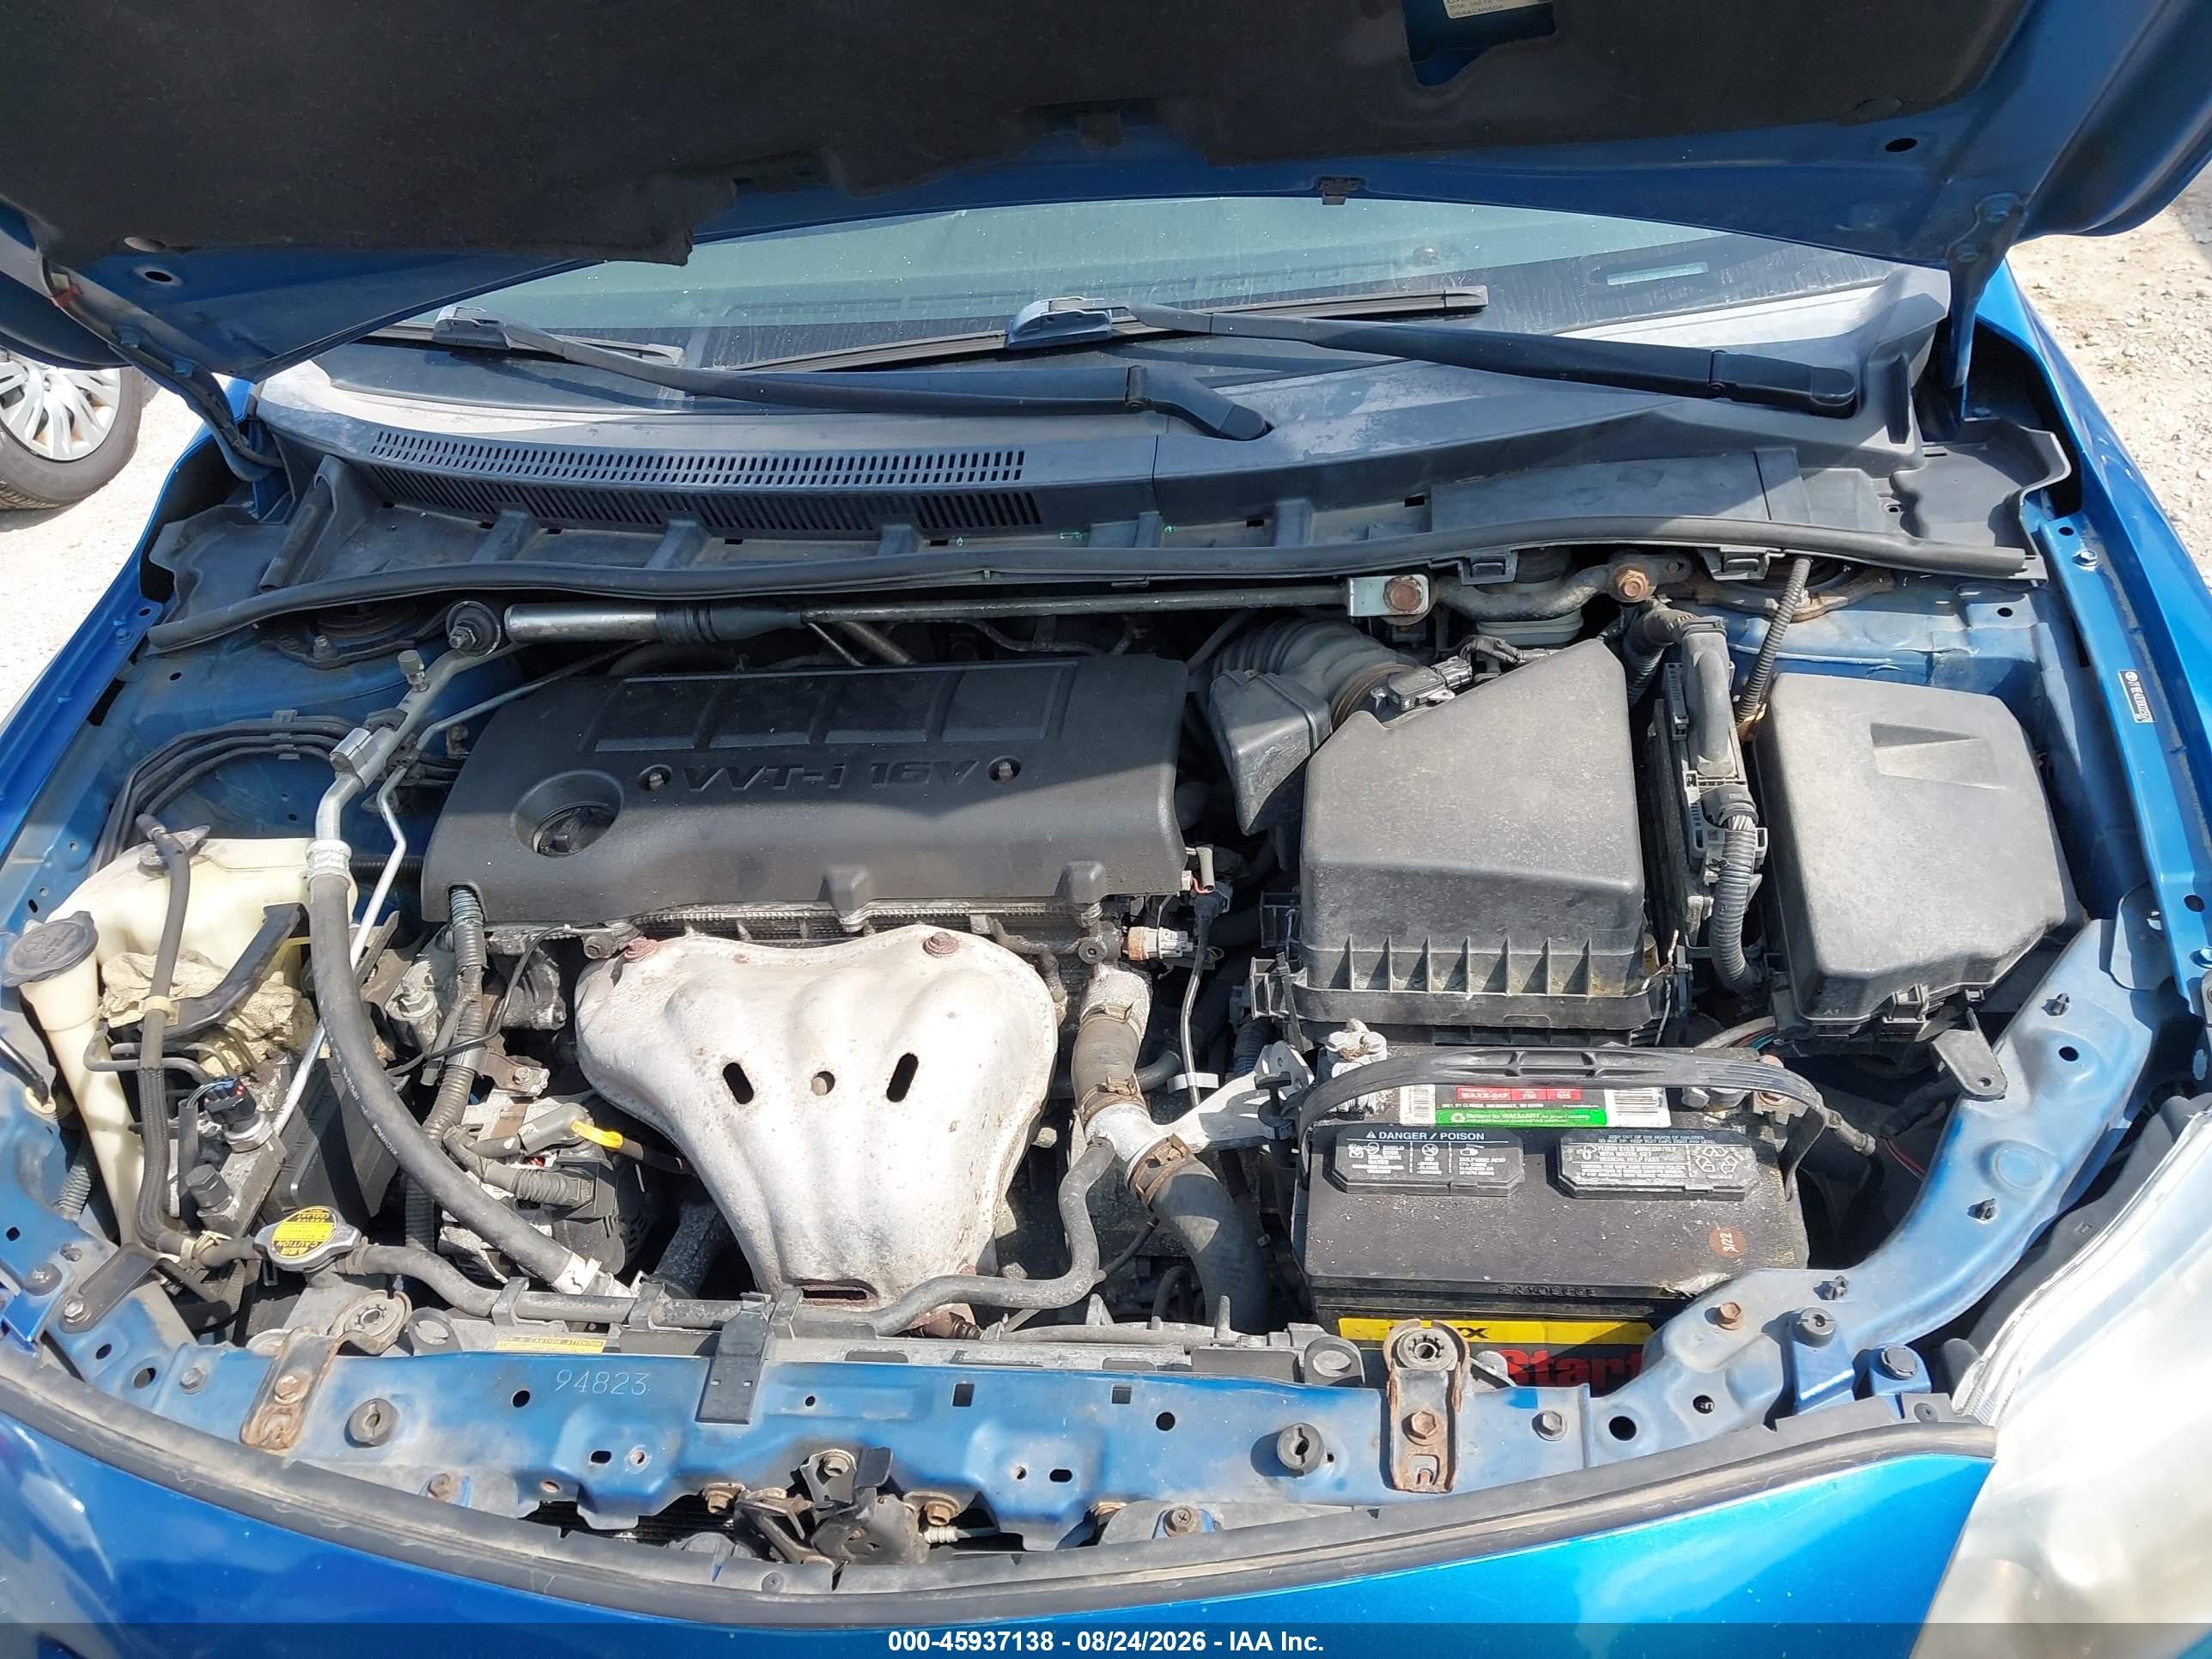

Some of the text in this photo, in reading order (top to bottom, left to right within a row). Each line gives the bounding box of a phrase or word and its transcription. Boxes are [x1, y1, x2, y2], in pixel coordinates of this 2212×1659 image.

[870, 761, 980, 787] 16V
[1379, 1131, 1485, 1140] DANGER / POISON
